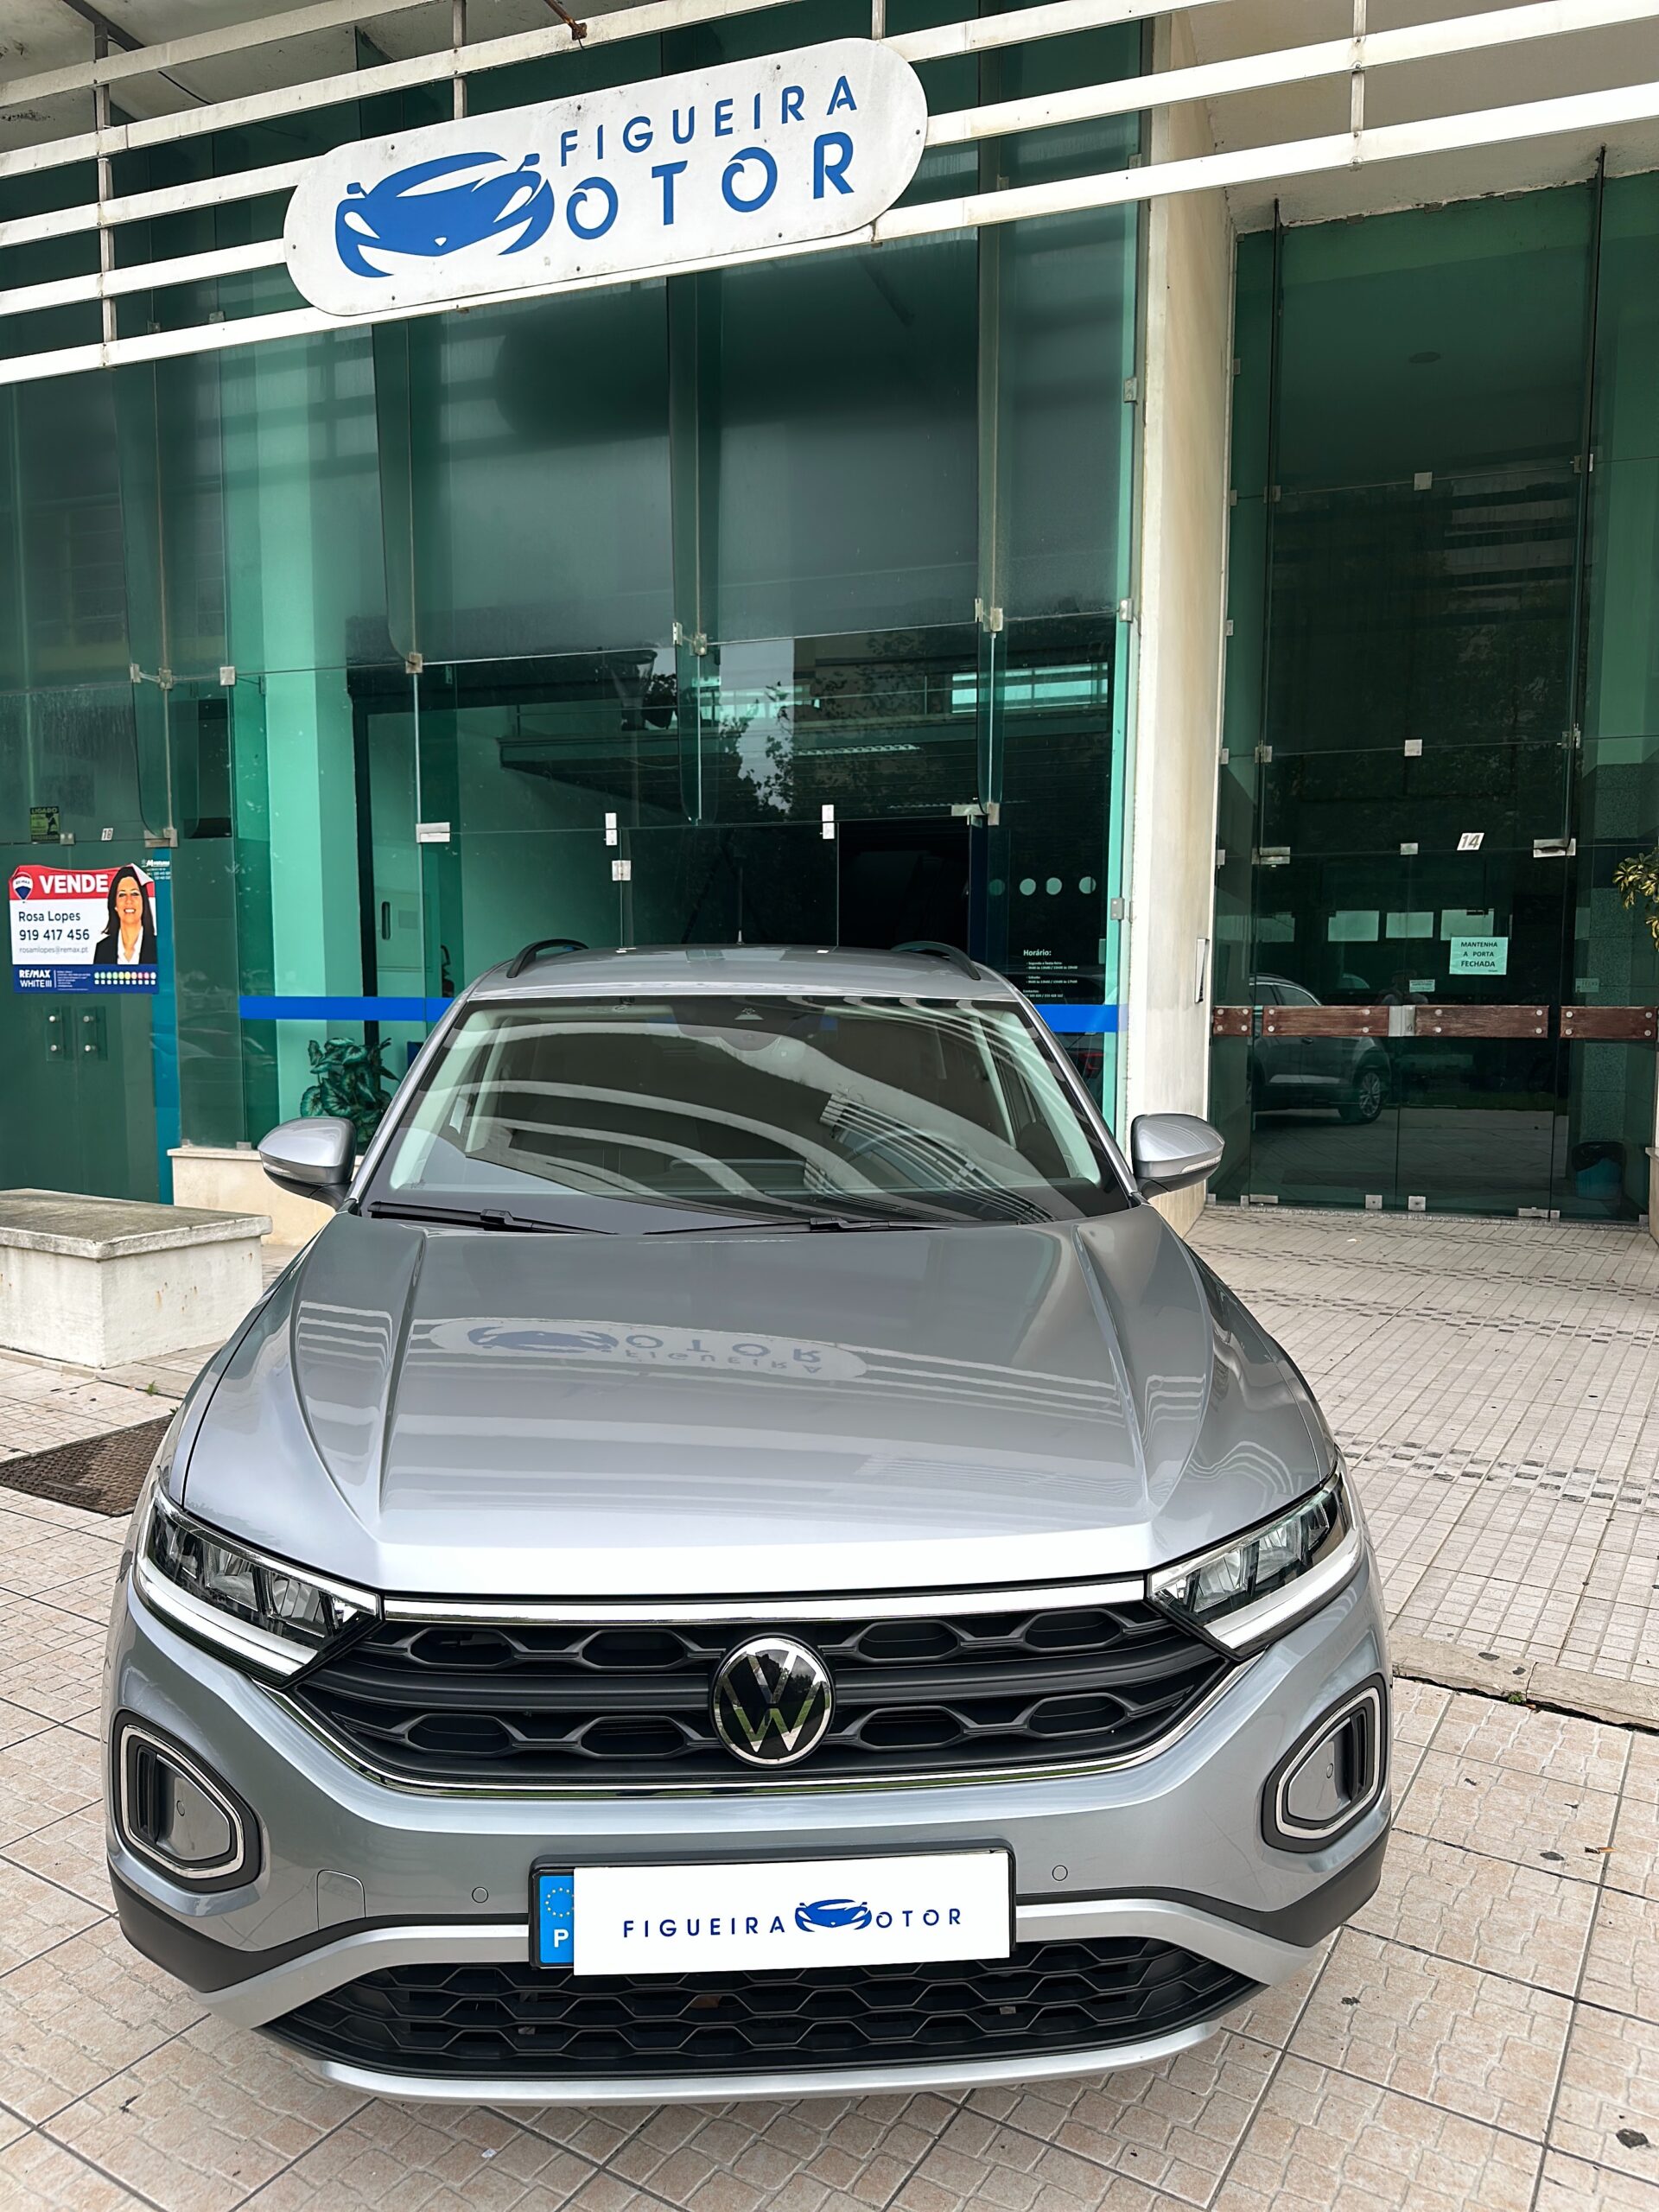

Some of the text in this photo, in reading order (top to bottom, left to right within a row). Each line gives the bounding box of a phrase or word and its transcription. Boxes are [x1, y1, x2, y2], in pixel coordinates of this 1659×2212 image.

[560, 75, 857, 167] FIGUEIRA
[1461, 834, 1480, 849] 14
[39, 874, 109, 894] VENDE
[18, 911, 81, 924] Rosa Lopes
[19, 929, 90, 941] 919 417 456
[19, 969, 51, 978] RE/MAX
[623, 1915, 785, 1938] FIGUEIRA
[553, 1929, 569, 1948] P
